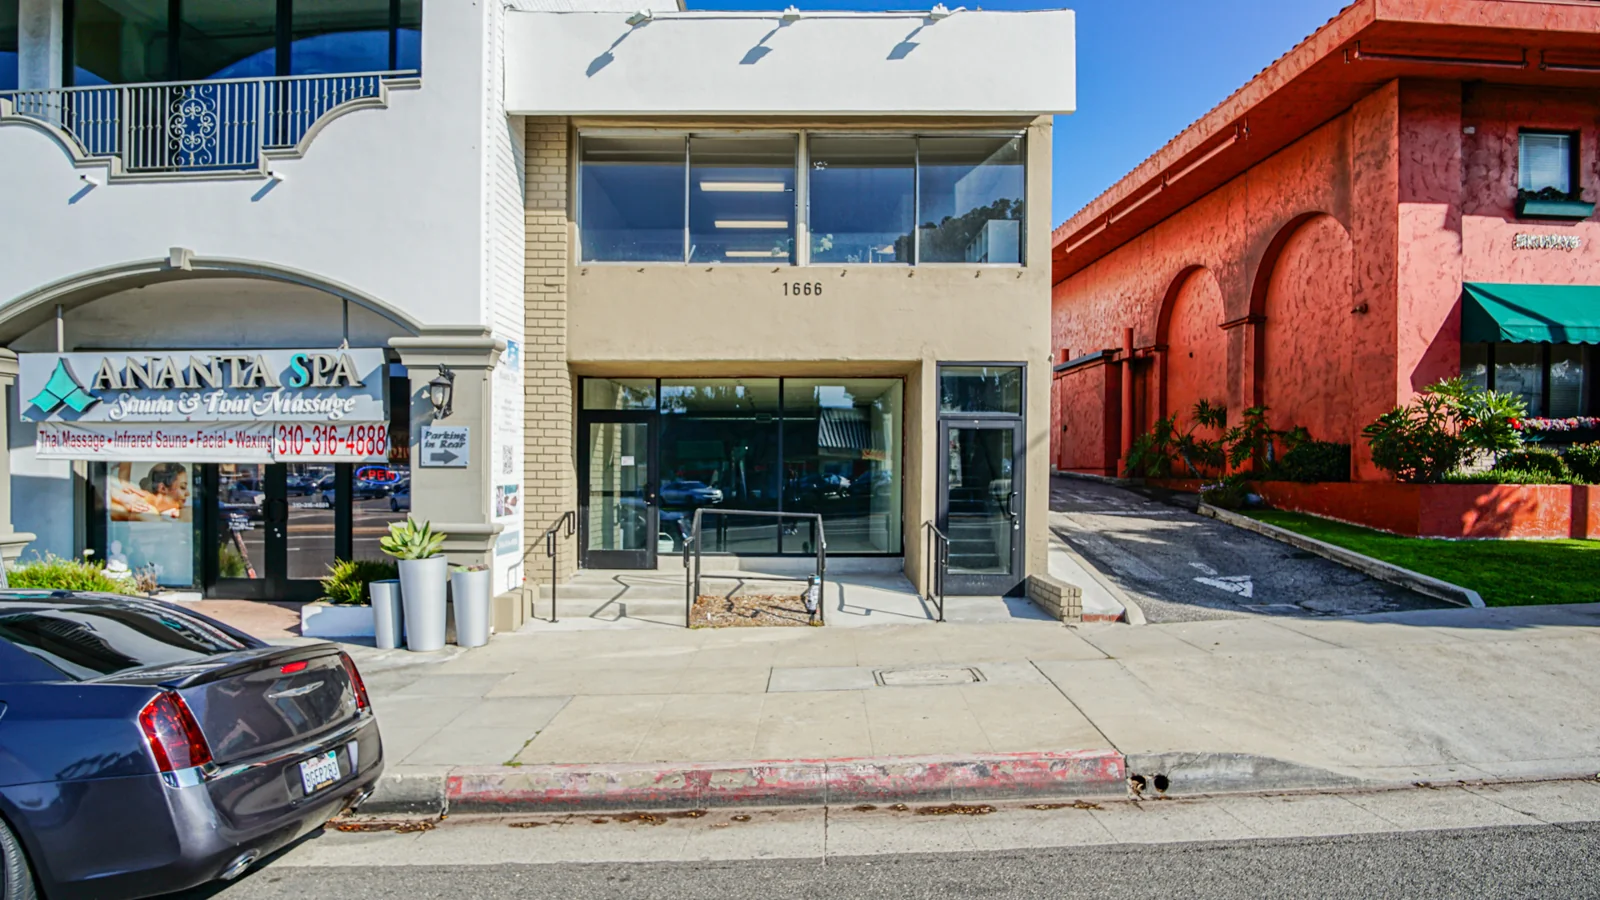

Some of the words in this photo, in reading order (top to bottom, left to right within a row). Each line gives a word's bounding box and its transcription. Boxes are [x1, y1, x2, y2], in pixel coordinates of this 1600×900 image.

[782, 282, 823, 296] 1666
[92, 354, 281, 389] ANANTA
[289, 353, 364, 388] SPA
[252, 386, 357, 420] Massage
[39, 430, 60, 448] Thai
[62, 430, 105, 452] Massage
[114, 430, 153, 448] Infrared
[155, 430, 188, 448] Sauna
[196, 430, 227, 448] Facial
[235, 430, 273, 453] Waxing
[278, 424, 387, 456] 310-316-4888
[424, 431, 467, 442] Parking
[424, 440, 436, 449] in
[439, 440, 467, 449] Rear
